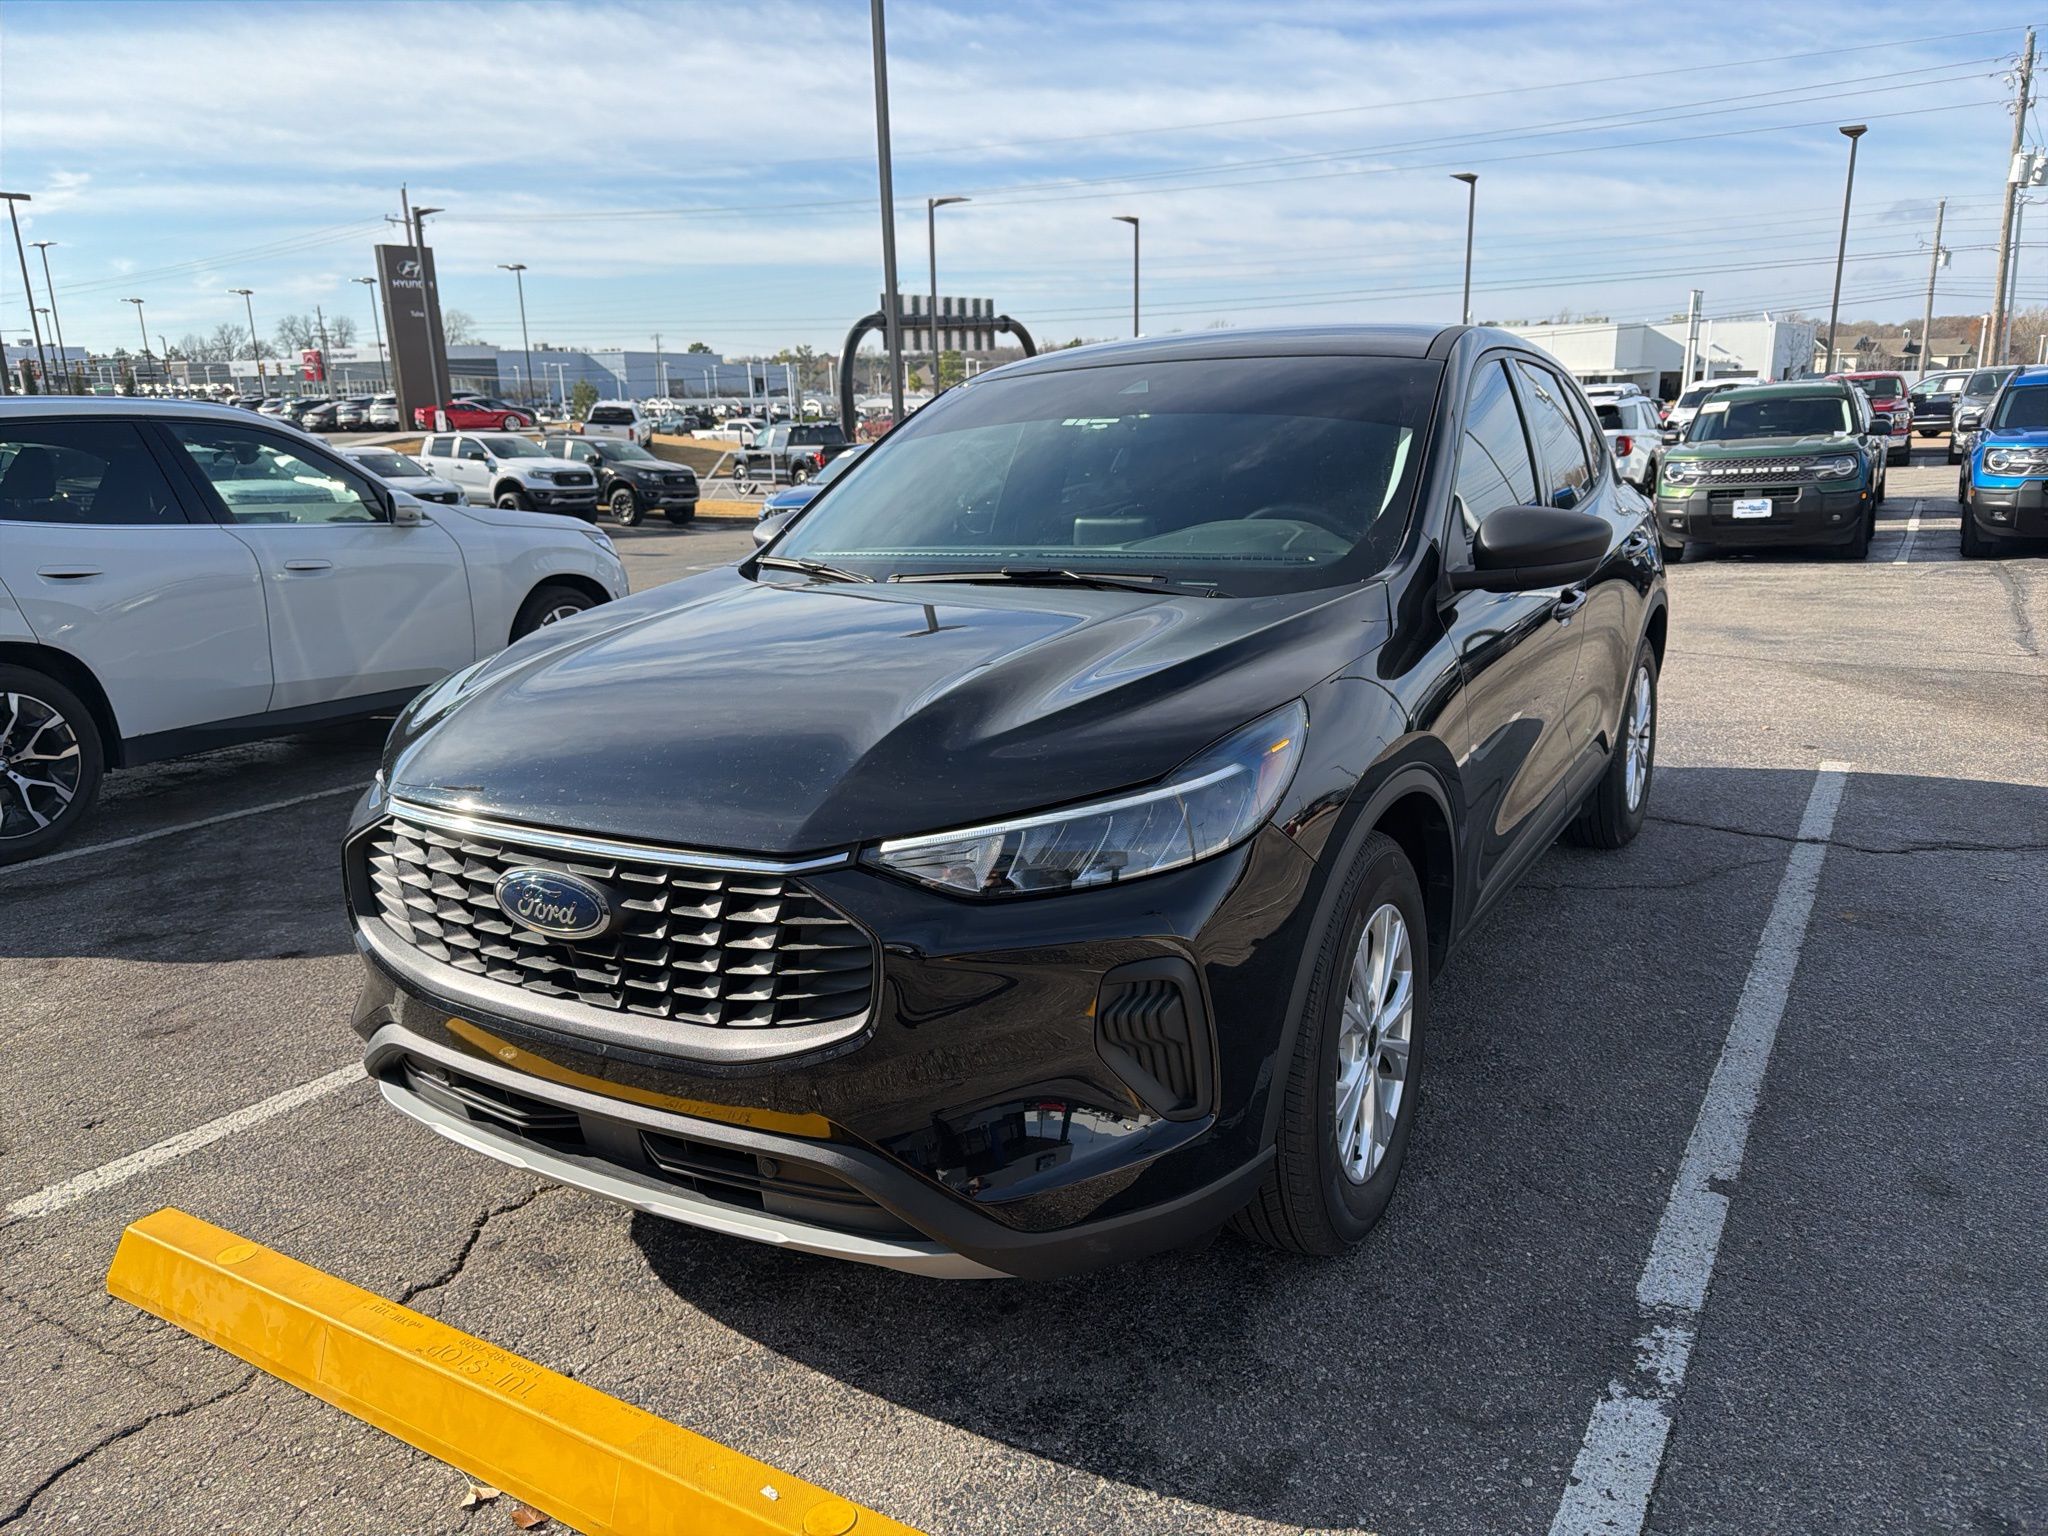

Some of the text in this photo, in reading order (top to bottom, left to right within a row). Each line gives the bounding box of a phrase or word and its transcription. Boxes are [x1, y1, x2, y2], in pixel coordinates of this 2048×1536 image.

[392, 279, 434, 289] HYUNDI
[1710, 466, 1800, 476] BRONCO
[517, 884, 578, 926] Ford
